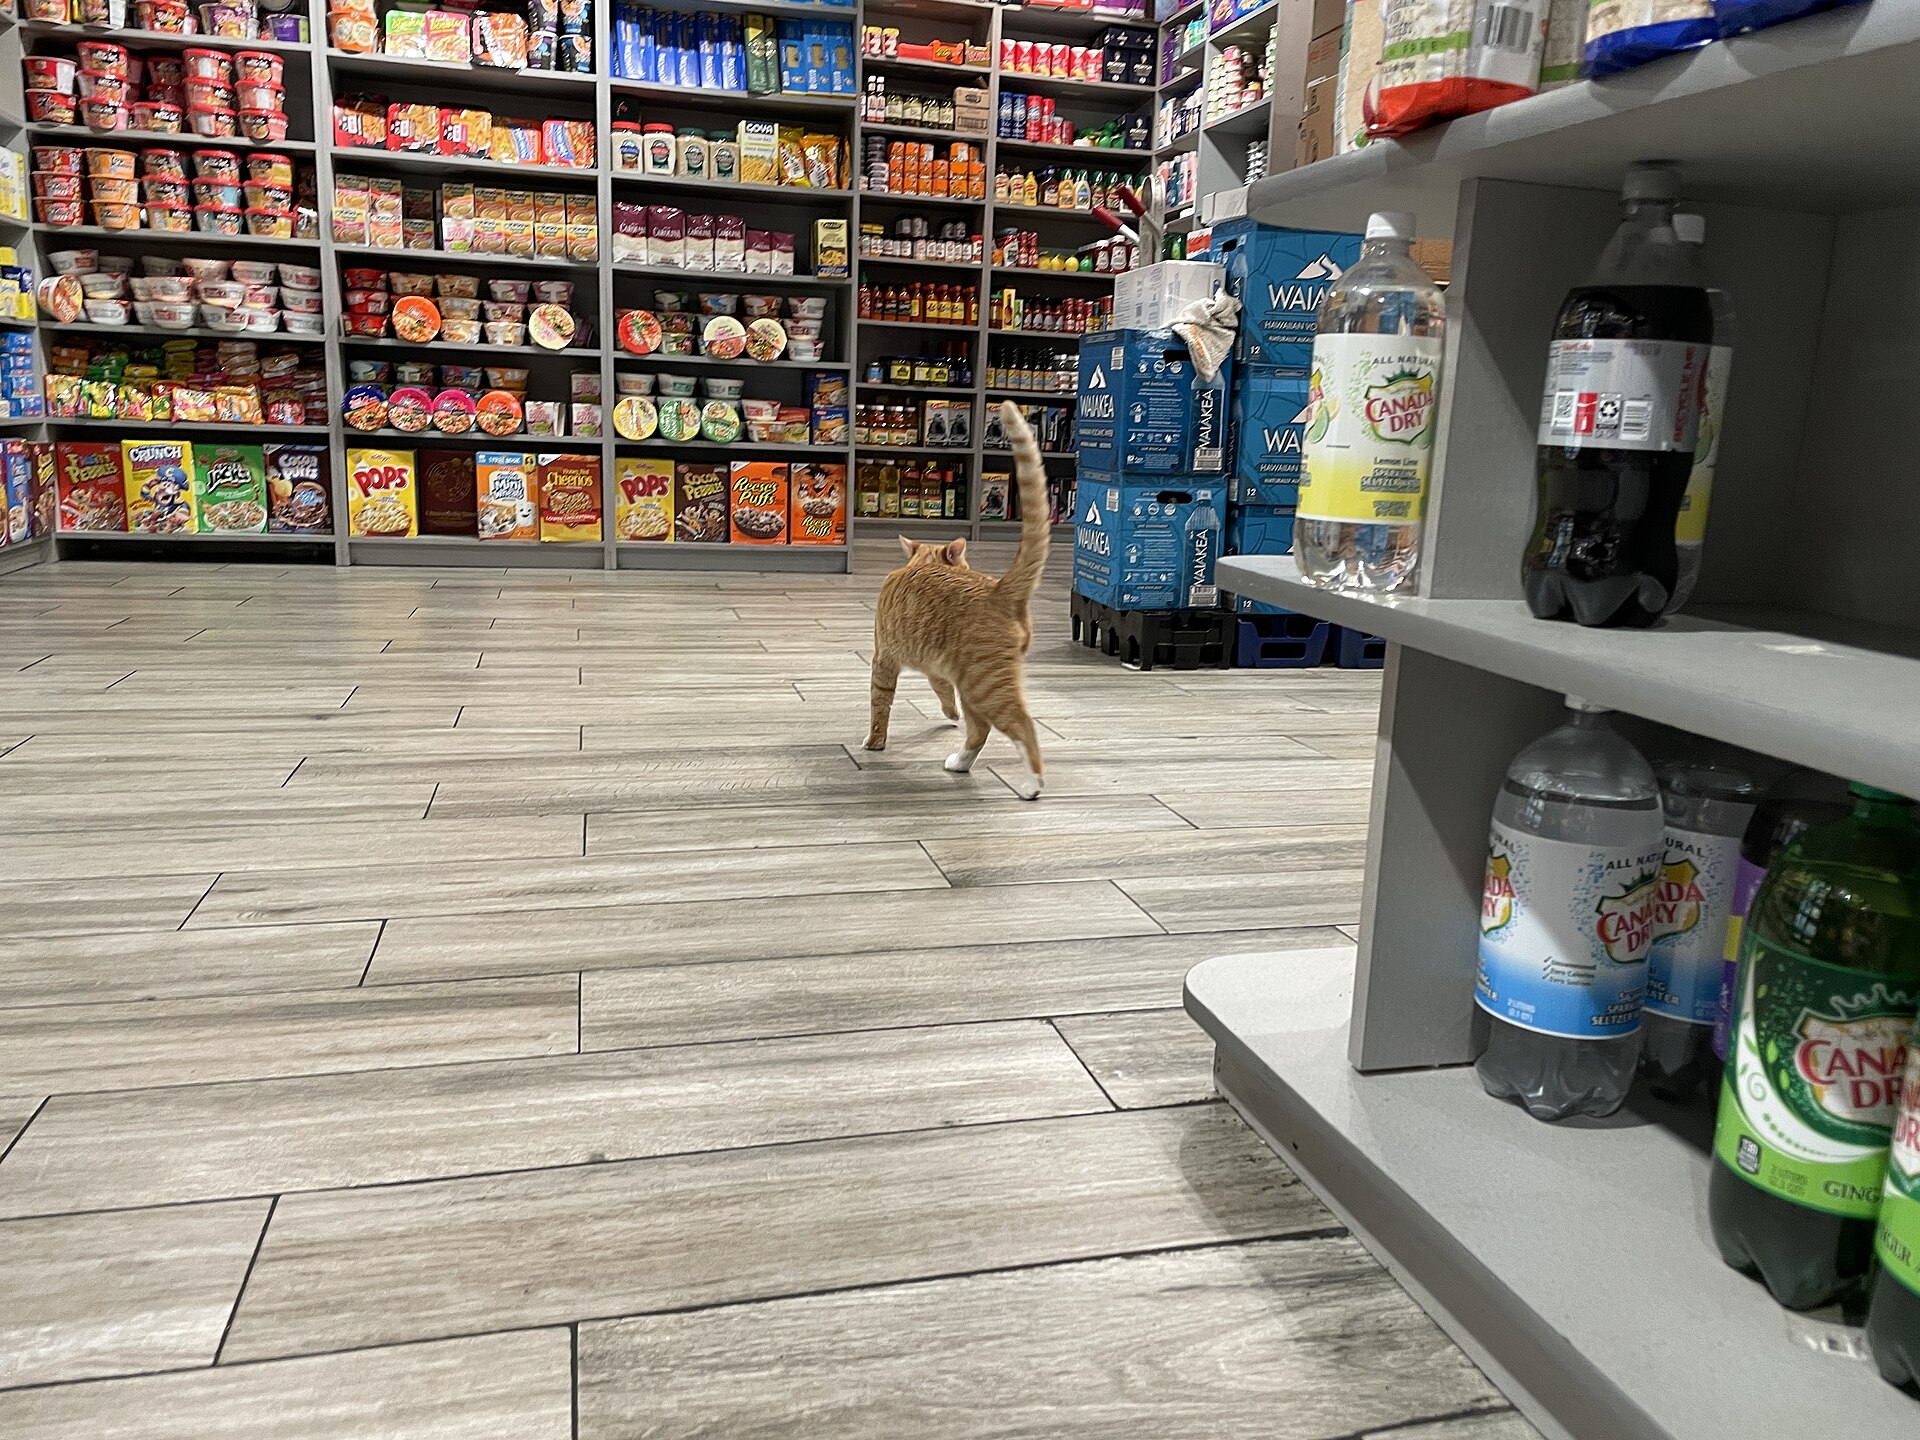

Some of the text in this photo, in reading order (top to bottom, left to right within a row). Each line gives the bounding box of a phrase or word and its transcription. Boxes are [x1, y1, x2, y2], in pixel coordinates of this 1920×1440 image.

[746, 121, 774, 134] GOYA
[1267, 283, 1327, 311] WAIA
[1250, 345, 1261, 355] 12
[1372, 355, 1394, 365] ALL
[1365, 390, 1433, 422] CANADA
[1389, 409, 1424, 433] DRY
[129, 445, 183, 462] CRUNCH
[352, 465, 409, 499] POPS
[493, 477, 523, 493] Mini
[546, 471, 594, 488] Cheerios
[620, 474, 671, 505] POPS
[738, 489, 776, 507] Puffs
[1246, 487, 1257, 497] 12
[1242, 600, 1252, 609] 12
[1605, 858, 1632, 871] ALL
[1798, 1039, 1908, 1086] CANA
[1851, 1074, 1903, 1109] DR
[1823, 1179, 1883, 1203] GING
